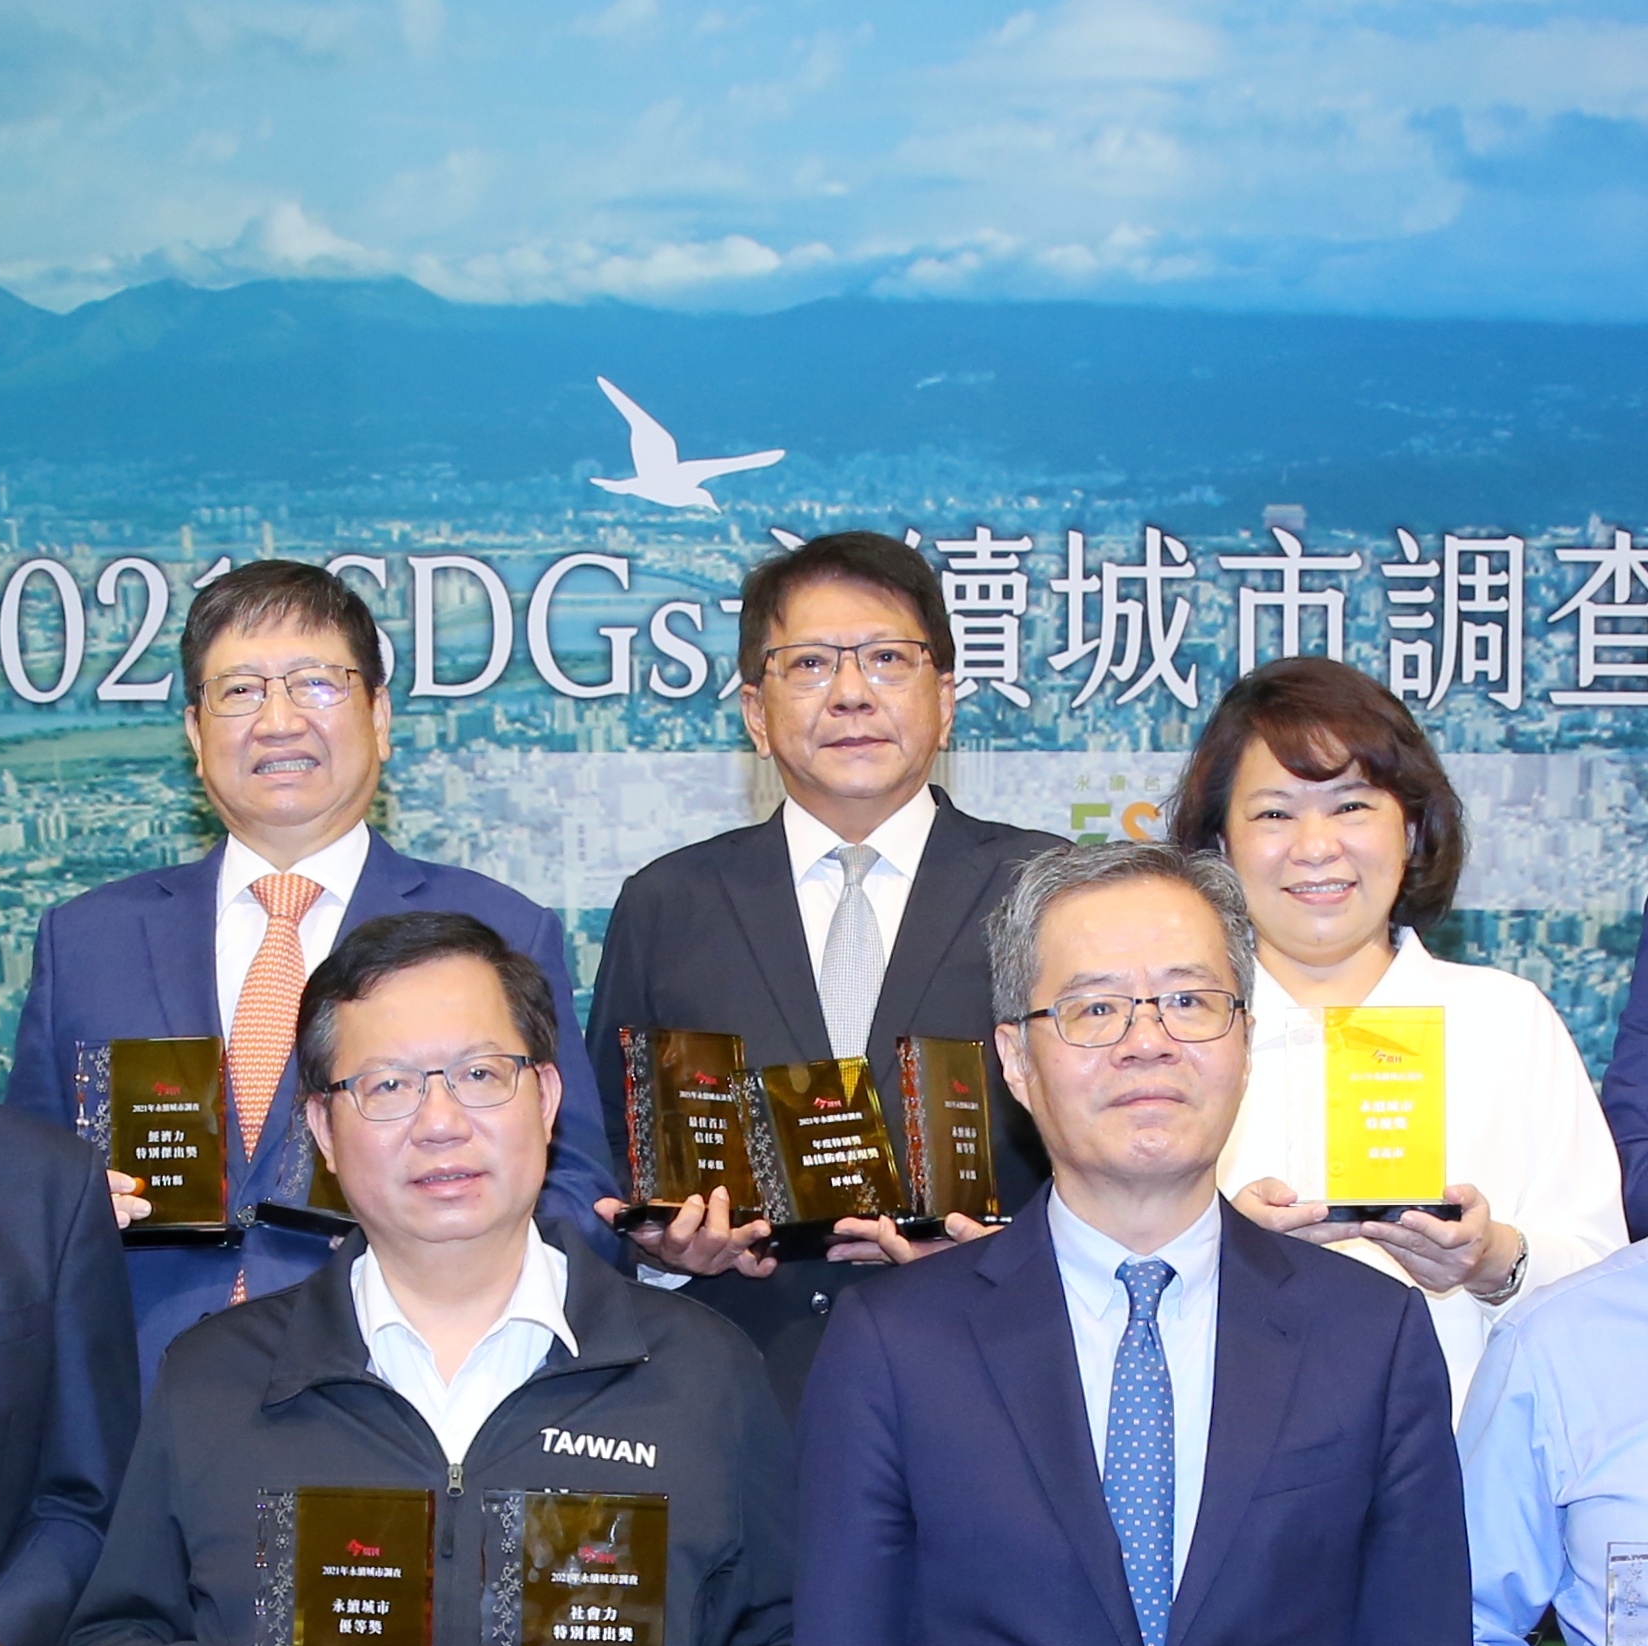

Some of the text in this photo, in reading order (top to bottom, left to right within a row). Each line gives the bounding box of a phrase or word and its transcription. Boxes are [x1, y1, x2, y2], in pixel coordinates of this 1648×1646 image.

[1075, 774, 1161, 792] 永續台
[148, 1130, 184, 1143] 經濟力
[136, 1147, 198, 1160] 特別傑出獎
[151, 1175, 183, 1186] 新竹縣
[540, 1427, 656, 1468] TAIWAN
[332, 1600, 390, 1615] 永續城市
[570, 1605, 618, 1621] 社會力
[339, 1619, 383, 1635] 優等獎
[552, 1624, 634, 1642] 特別傑出獎
